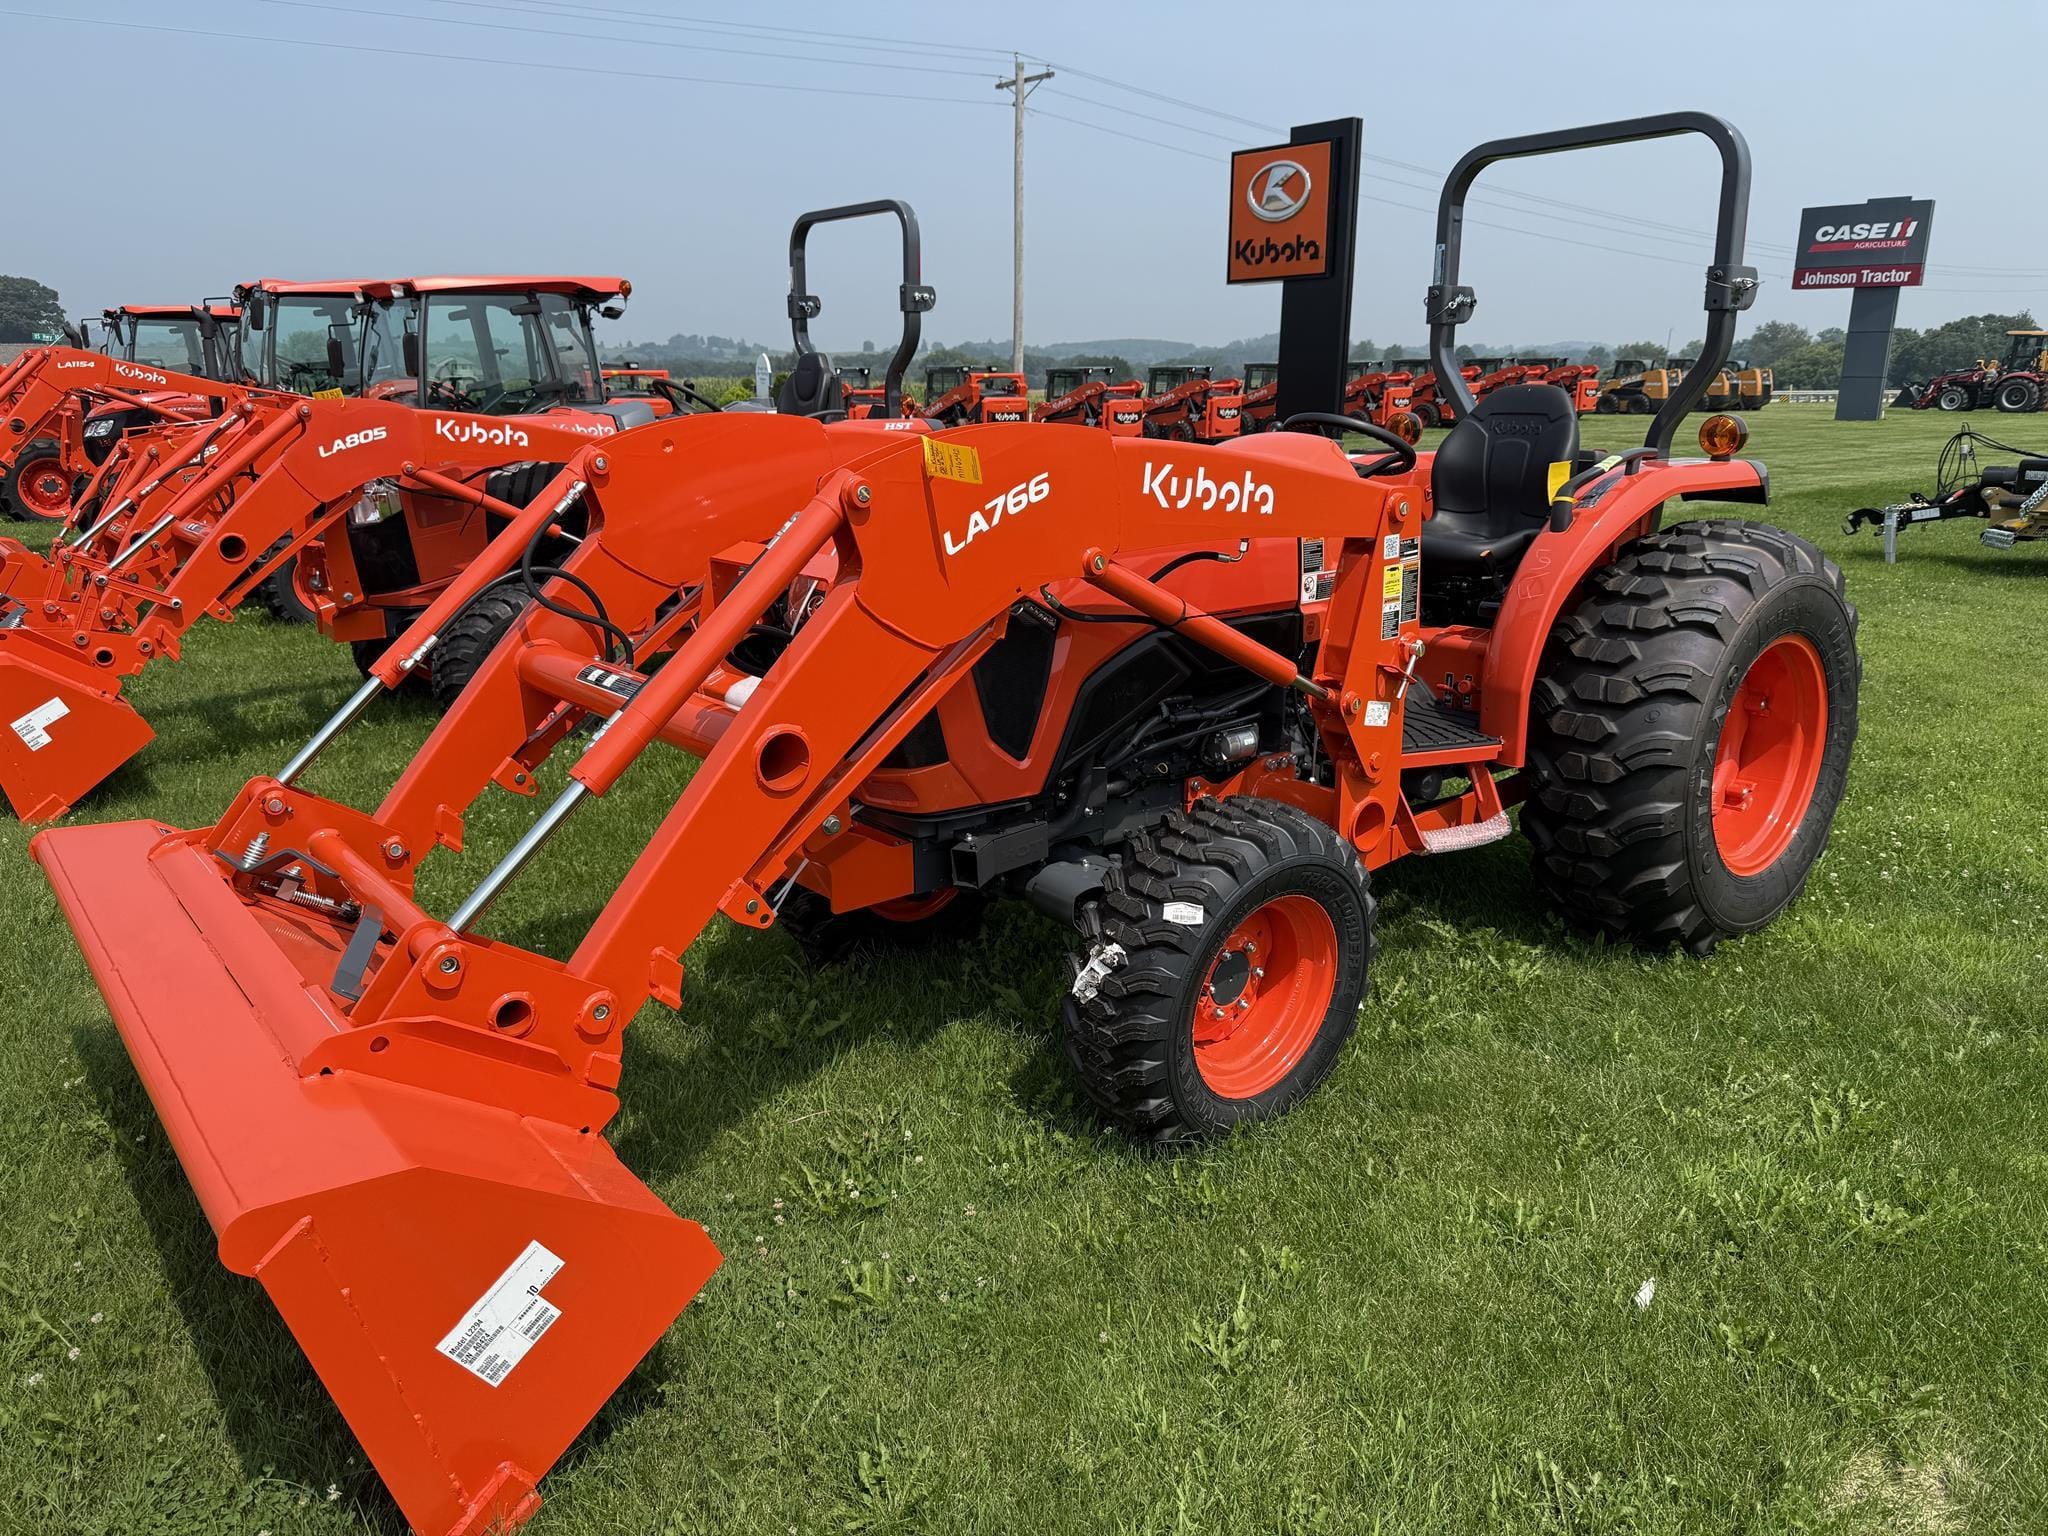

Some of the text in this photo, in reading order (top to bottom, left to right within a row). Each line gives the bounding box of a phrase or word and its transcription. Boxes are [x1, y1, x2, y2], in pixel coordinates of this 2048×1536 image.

[1815, 222, 1890, 243] CASE
[1235, 234, 1320, 266] Kubota
[1854, 239, 1907, 249] AGRICULTURE
[1800, 269, 1912, 286] Johnson Tractor
[57, 360, 96, 369] LA1154
[115, 363, 167, 385] Kubota
[995, 412, 1021, 422] Kubota
[1116, 412, 1139, 422] Kubota
[435, 418, 529, 448] Kubota
[884, 422, 913, 431] HST
[1490, 419, 1542, 437] Kubota
[318, 426, 388, 458] LA805
[1142, 462, 1275, 515] Kubota
[942, 472, 1050, 556] LA766
[526, 1284, 540, 1297] 10
[448, 1318, 485, 1356] Model L2294
[460, 1352, 473, 1365] S/N
